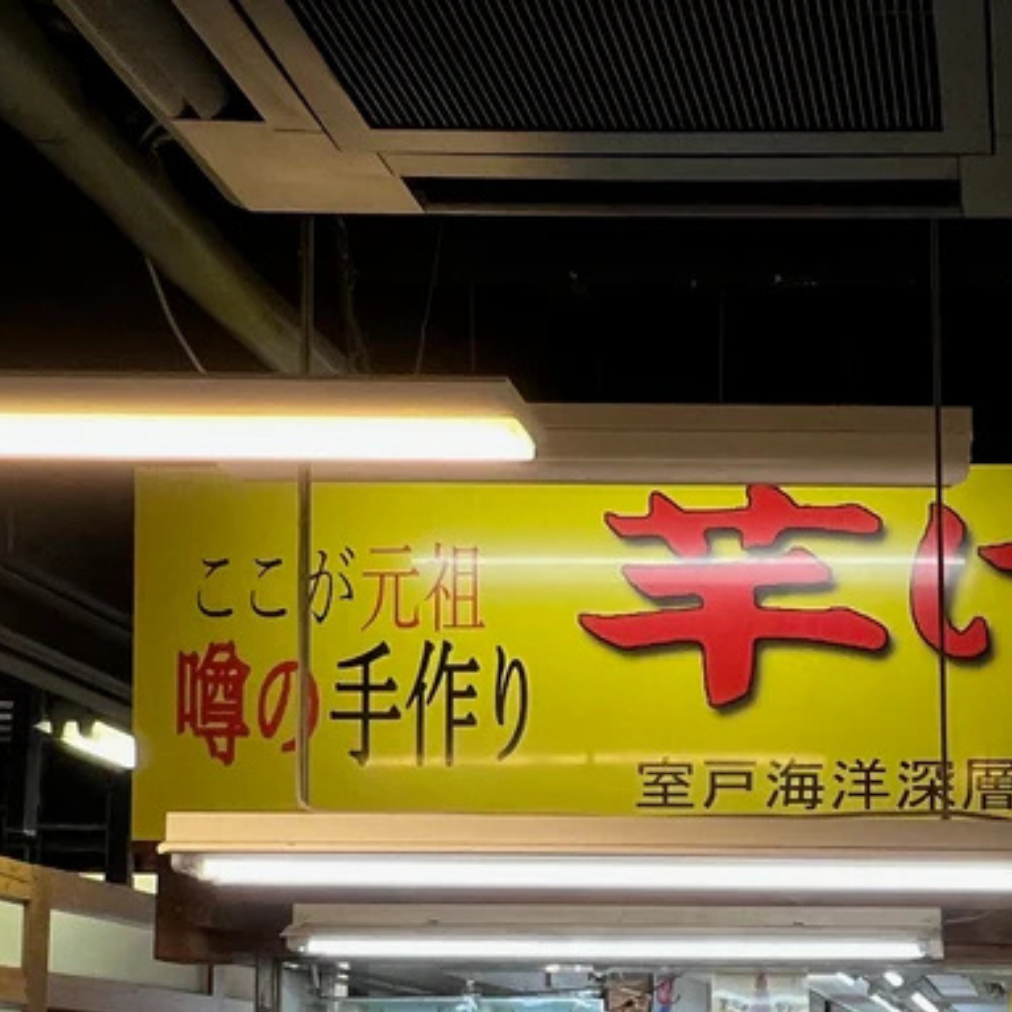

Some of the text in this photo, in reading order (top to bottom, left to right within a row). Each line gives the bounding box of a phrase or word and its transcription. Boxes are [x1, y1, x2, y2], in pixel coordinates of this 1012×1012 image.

[196, 541, 486, 632] ここが元祖
[175, 639, 530, 767] 噂の手作り
